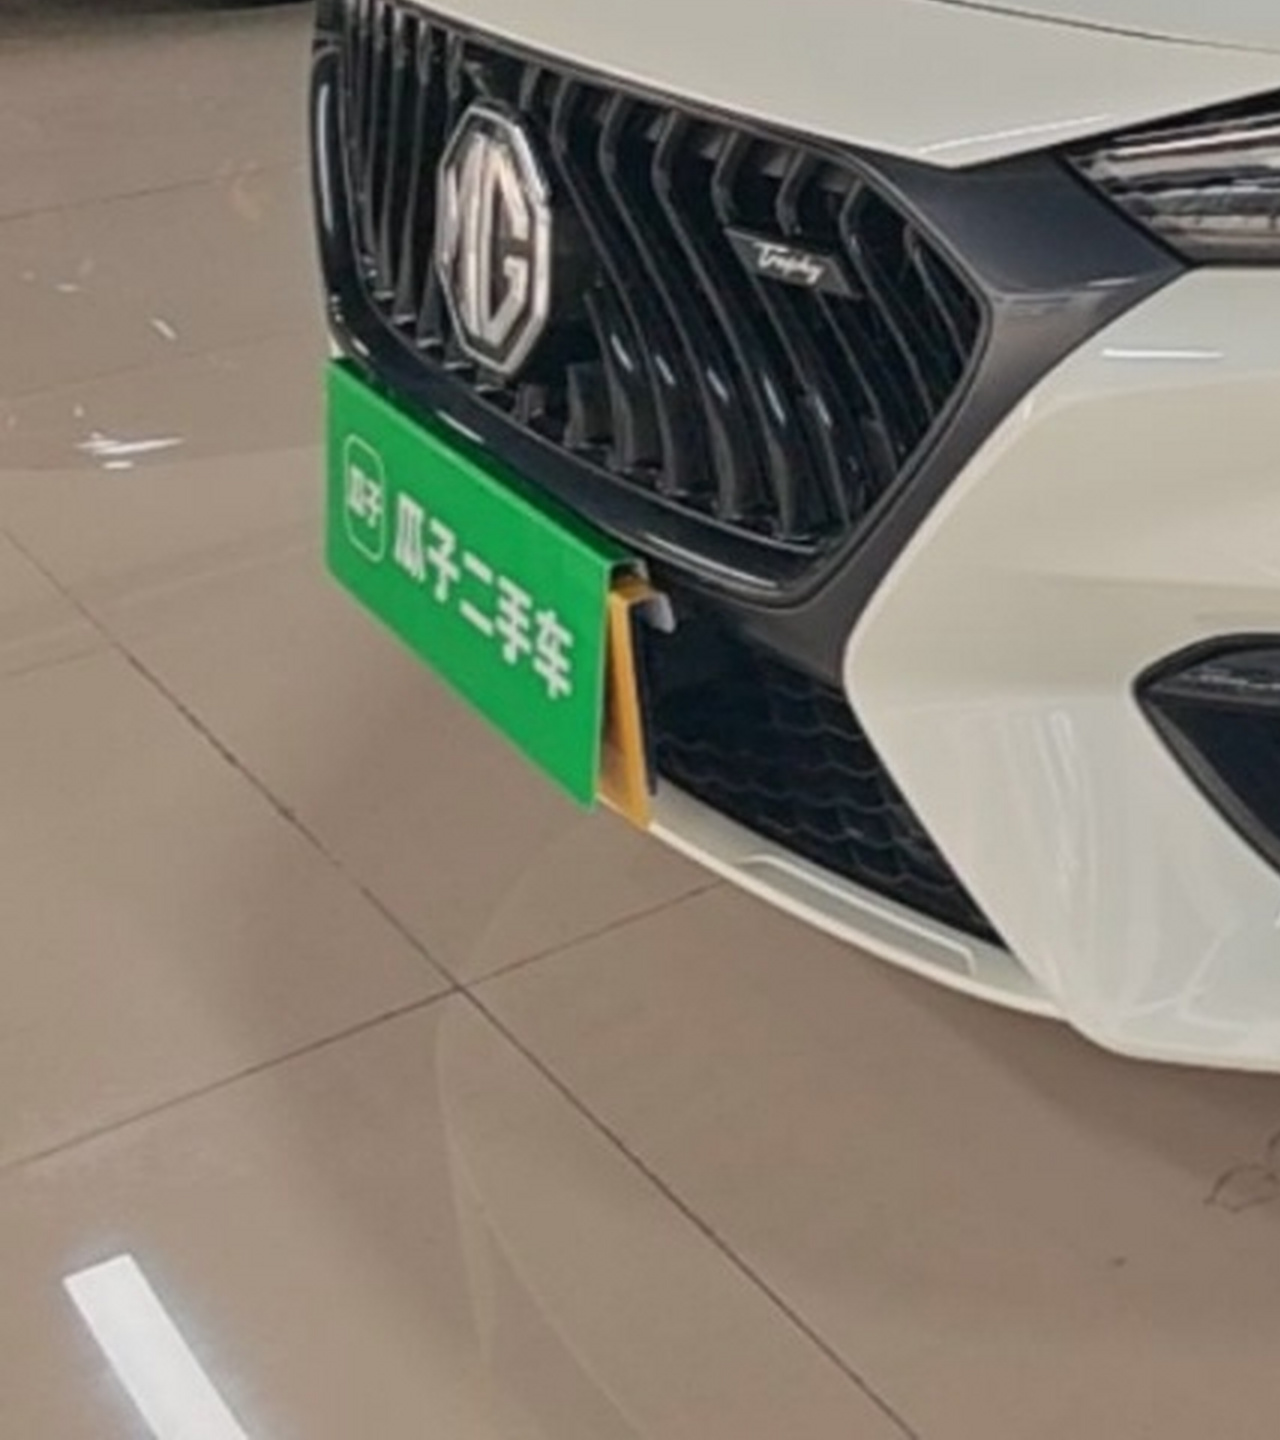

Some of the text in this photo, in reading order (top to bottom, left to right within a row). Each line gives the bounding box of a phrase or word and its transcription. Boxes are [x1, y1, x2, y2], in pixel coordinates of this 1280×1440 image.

[442, 130, 530, 348] MG
[394, 491, 575, 700] 瓜子二手车
